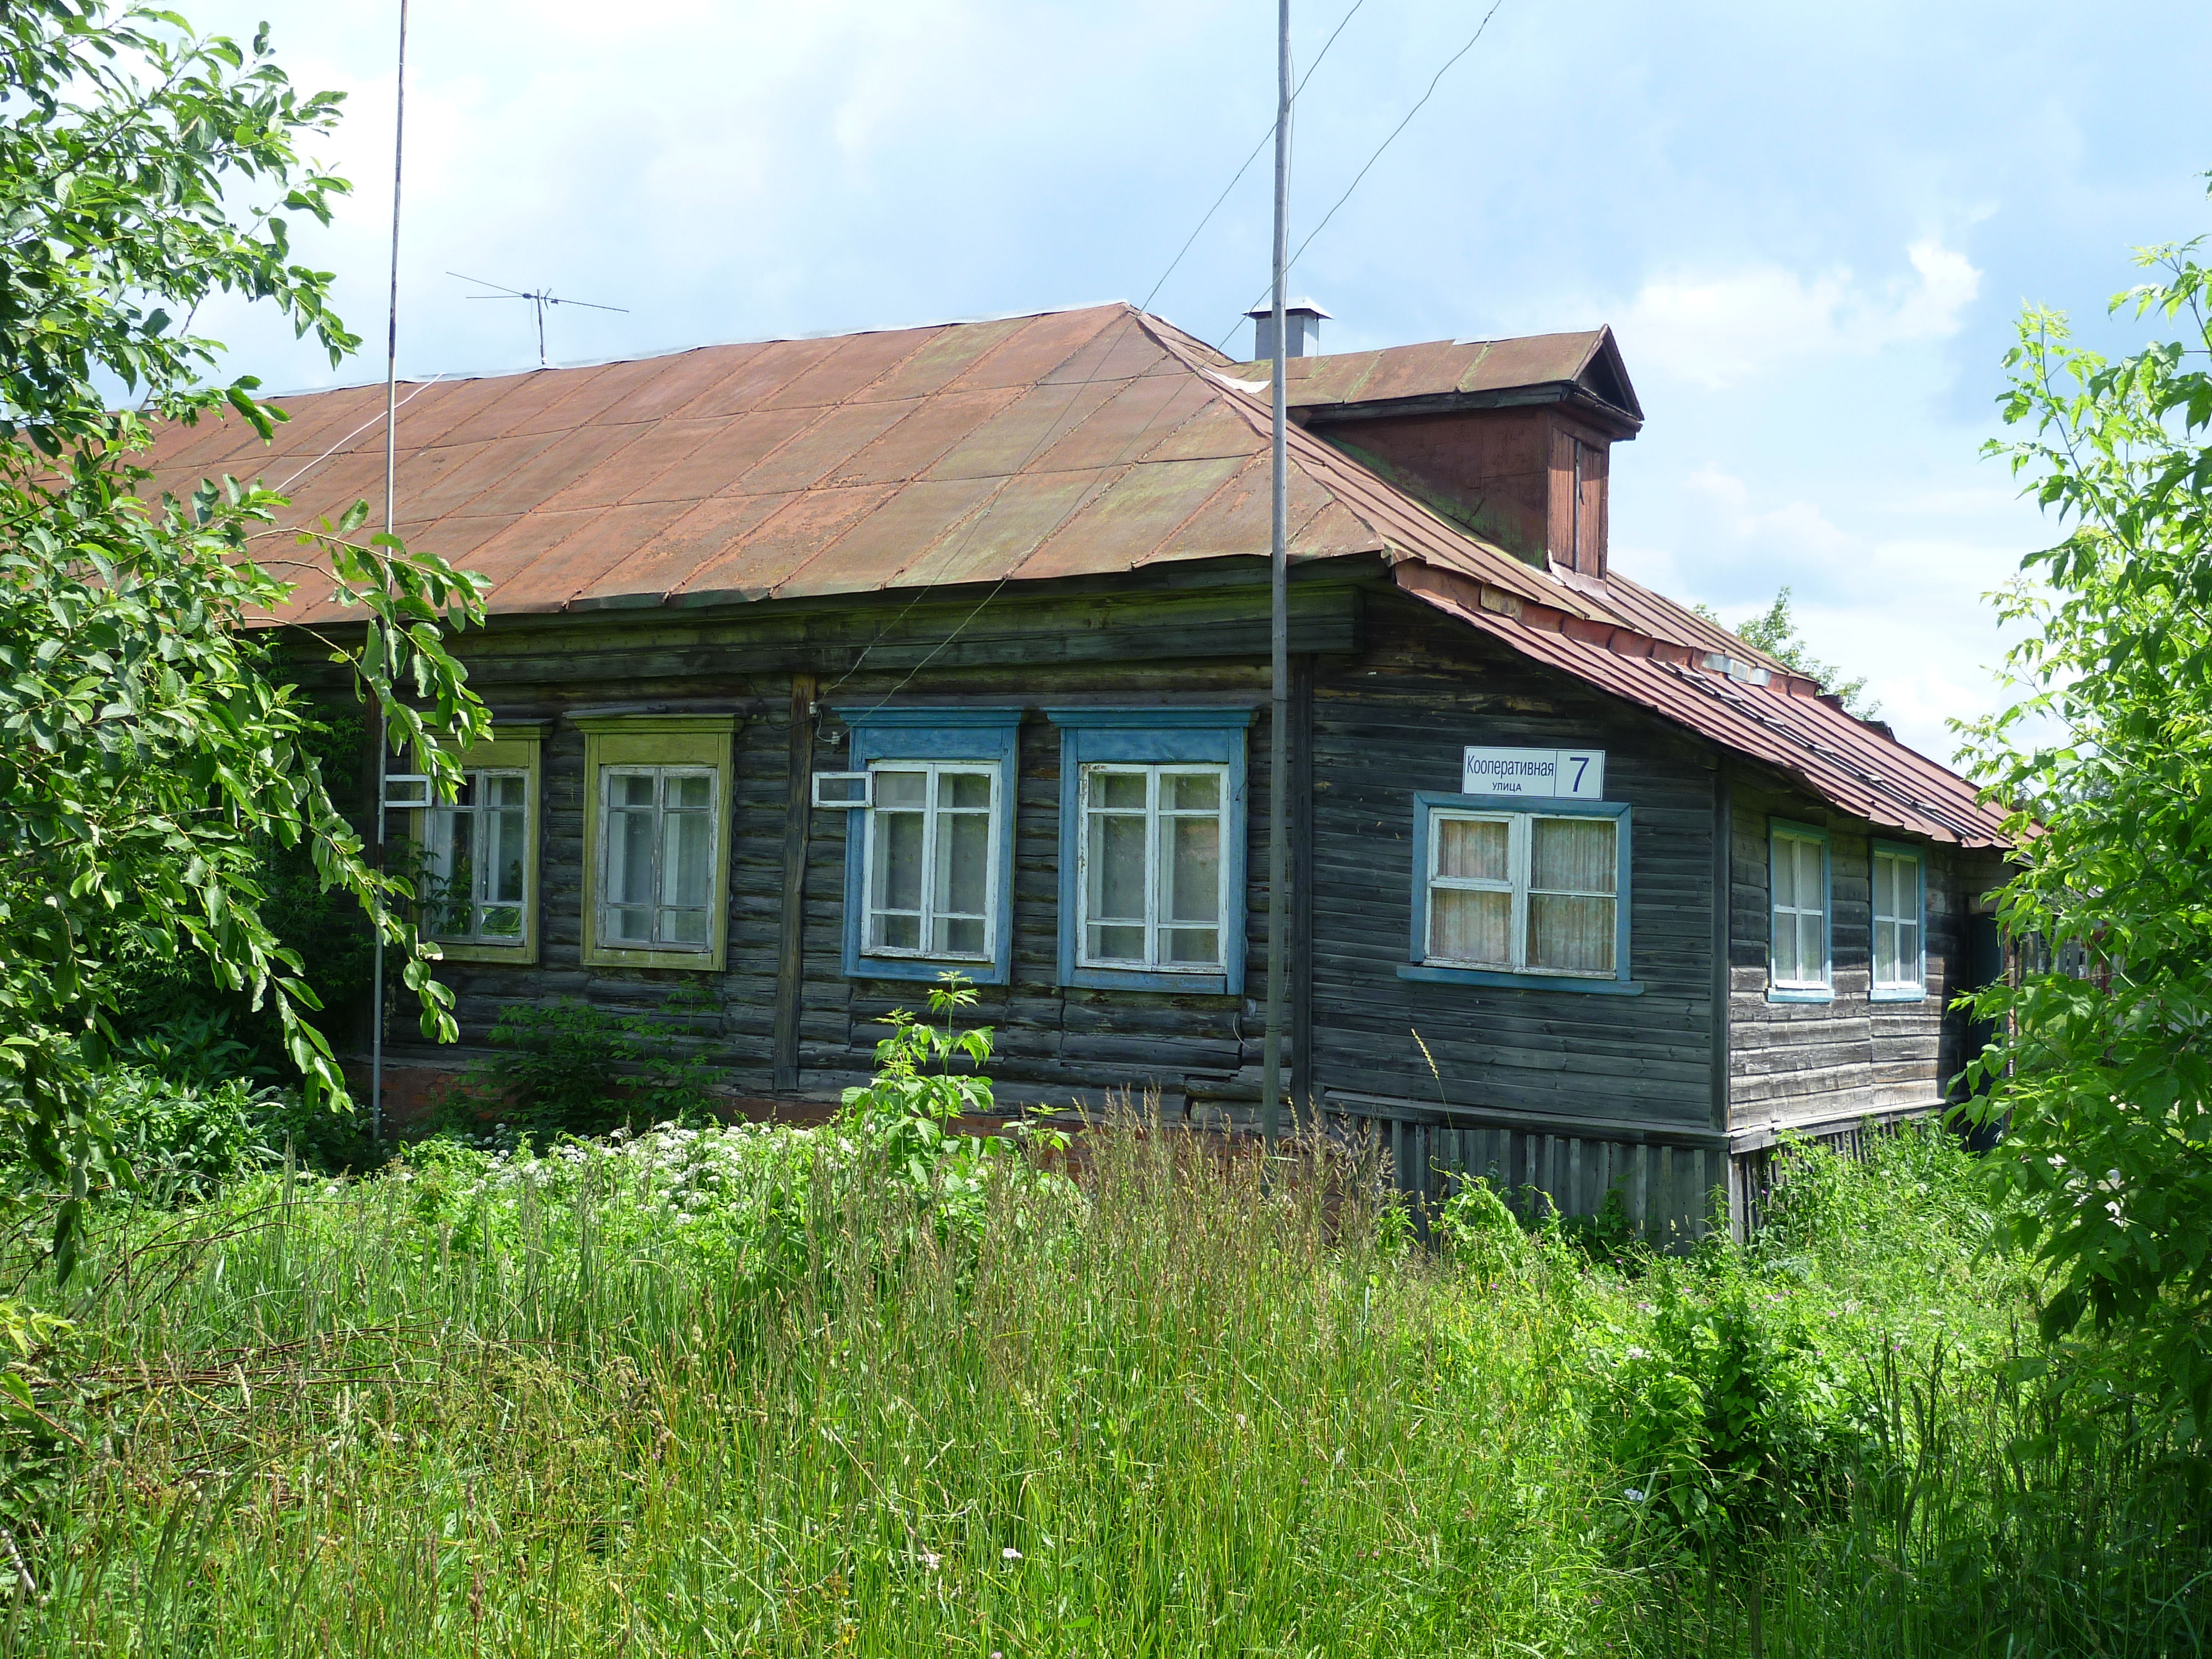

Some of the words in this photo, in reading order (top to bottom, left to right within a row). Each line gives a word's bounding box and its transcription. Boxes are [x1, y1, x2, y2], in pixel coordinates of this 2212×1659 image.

[1467, 755, 1554, 779] Кооперативная
[1569, 757, 1589, 792] 7
[1492, 782, 1522, 792] УЛИЦА
